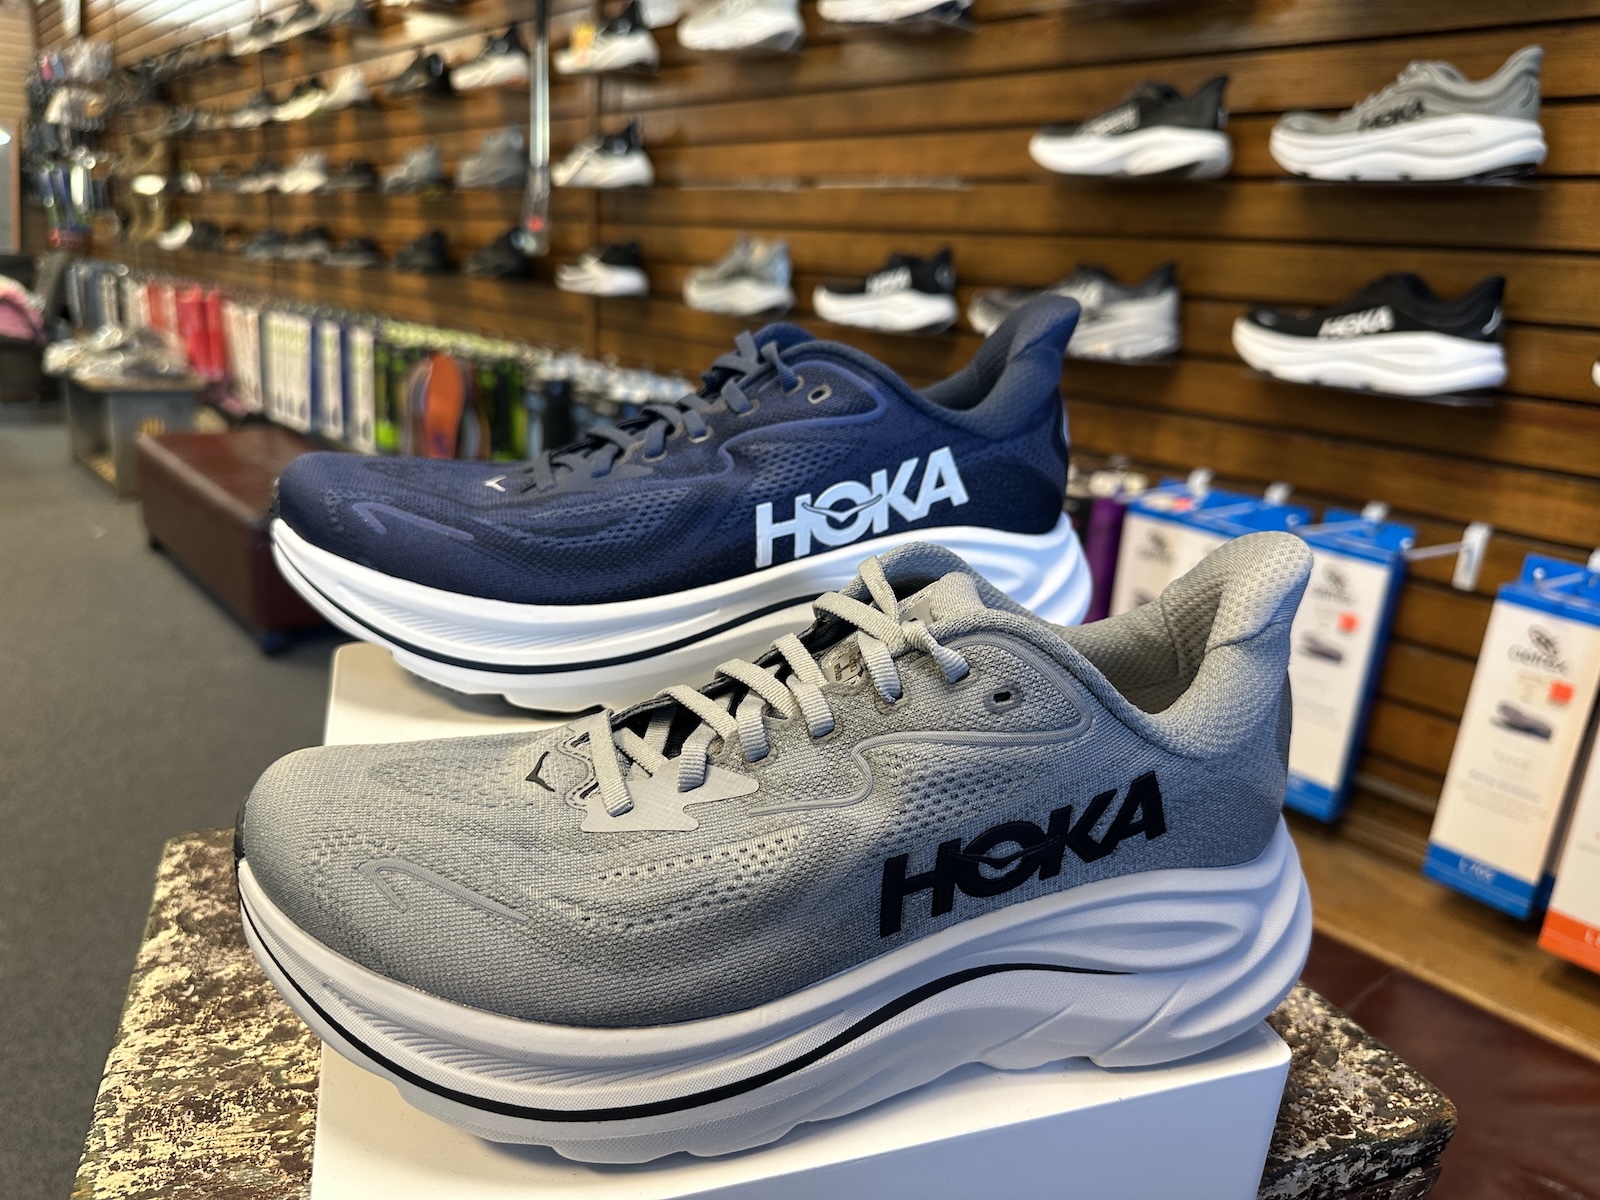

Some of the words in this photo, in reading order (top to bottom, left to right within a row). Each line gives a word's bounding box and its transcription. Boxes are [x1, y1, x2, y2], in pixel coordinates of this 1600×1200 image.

[1317, 305, 1395, 337] HOKA
[756, 446, 969, 567] HOKA
[881, 771, 1166, 937] HOKA
